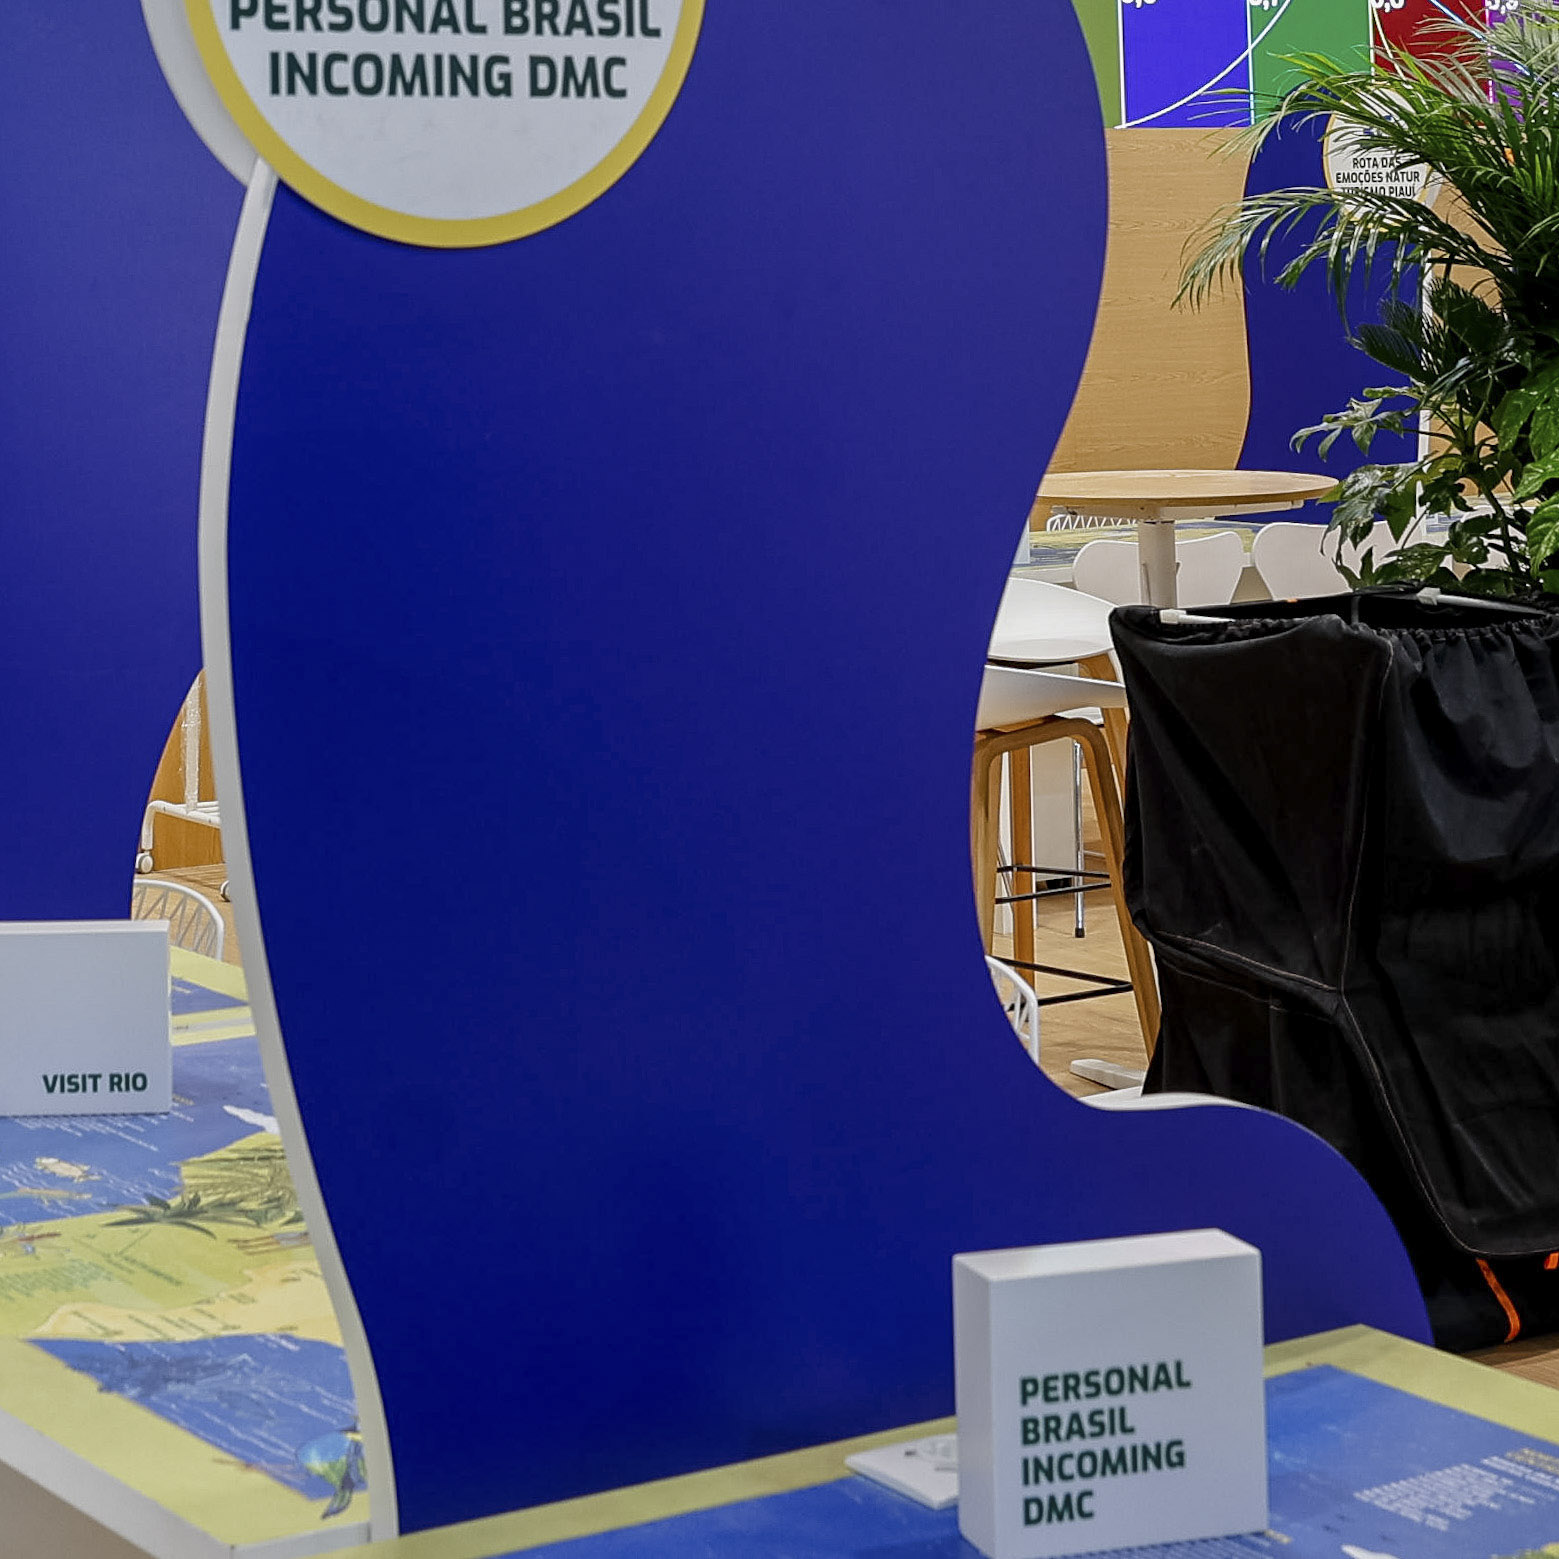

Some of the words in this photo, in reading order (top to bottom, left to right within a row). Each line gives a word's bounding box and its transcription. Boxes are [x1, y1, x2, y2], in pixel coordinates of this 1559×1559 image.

[270, 51, 513, 98] INCOMING
[529, 55, 627, 99] DMC
[1336, 170, 1383, 186] EMOÇÕES
[1385, 170, 1420, 183] NATUR
[1352, 157, 1378, 170] ROTA
[42, 1073, 103, 1095] VISIT
[109, 1073, 148, 1094] RIO
[1020, 1360, 1191, 1406] PERSONAL
[1022, 1406, 1135, 1445] BRASIL
[1022, 1439, 1186, 1486] INCOMING
[1023, 1490, 1094, 1526] DMC
